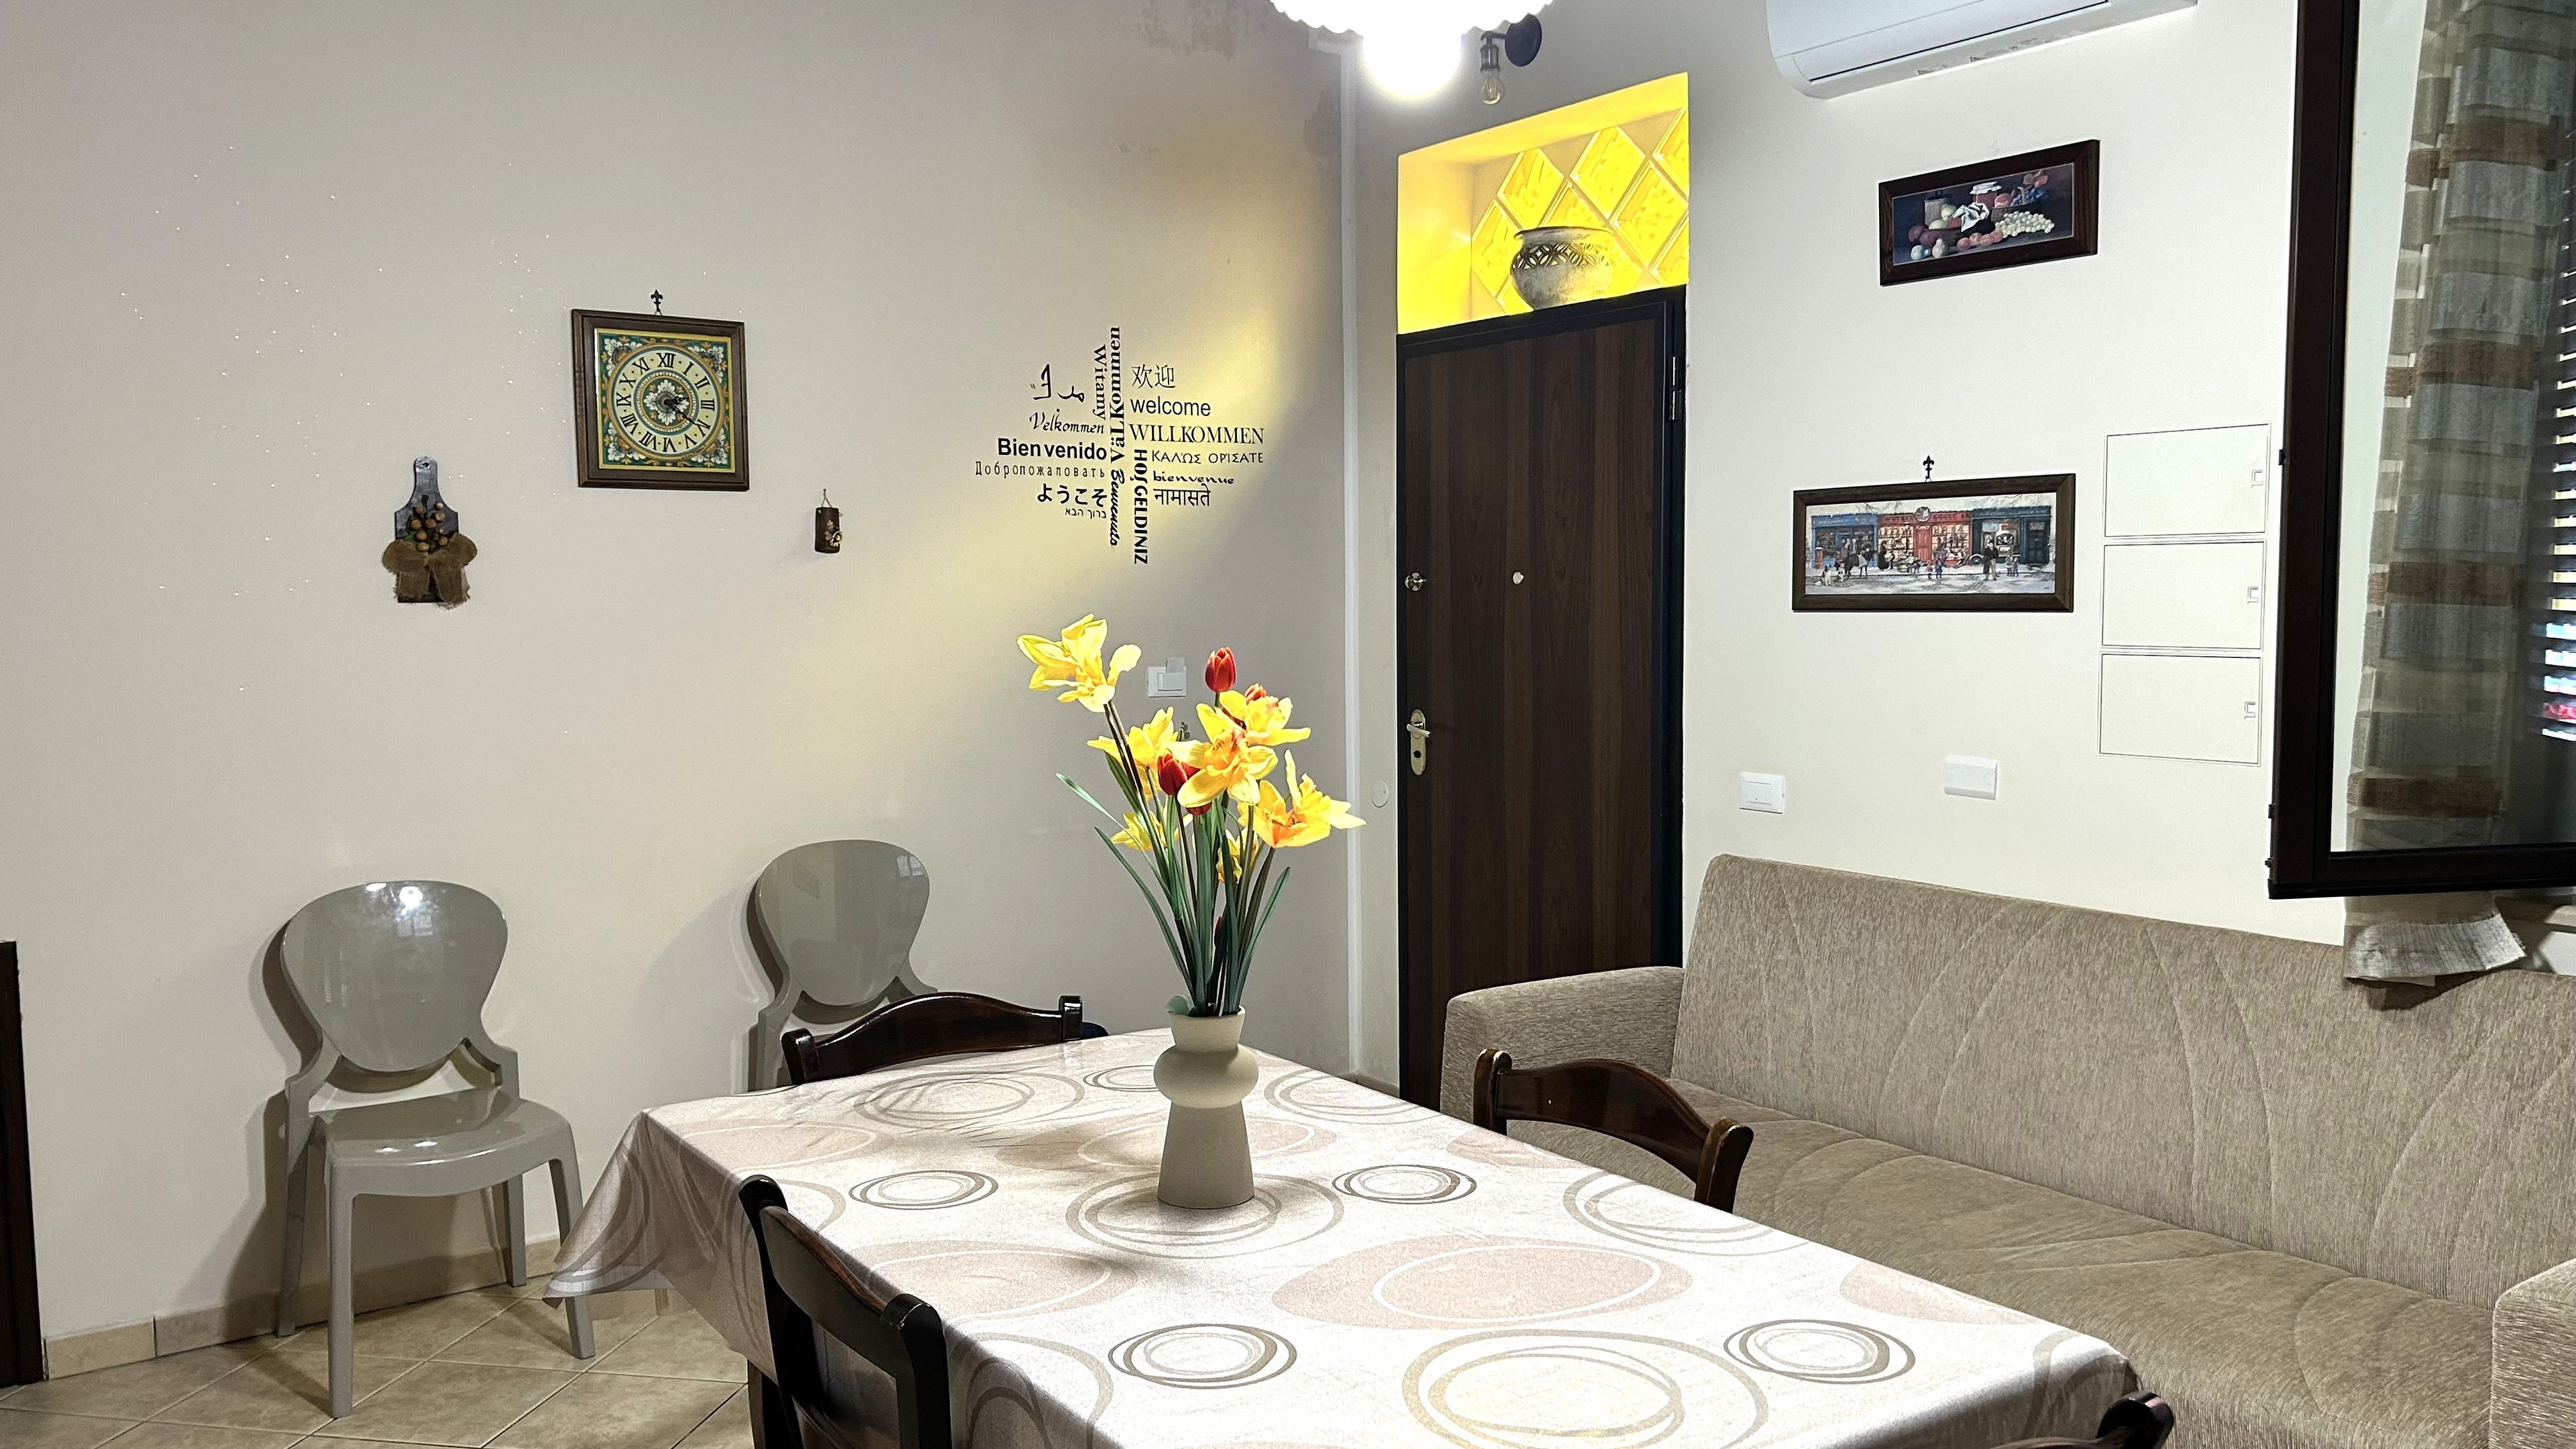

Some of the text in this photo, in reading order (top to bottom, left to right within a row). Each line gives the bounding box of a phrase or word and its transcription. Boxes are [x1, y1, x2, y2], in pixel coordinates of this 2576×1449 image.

[1093, 344, 1107, 420] Witamy
[1132, 364, 1175, 388] 欢迎
[1130, 396, 1210, 416] welcome
[1029, 411, 1104, 433] Velkommen
[1128, 424, 1264, 444] WILLKOMMEN
[976, 462, 1104, 478] Добропожаловать
[1153, 470, 1234, 484] bienvenue
[1038, 484, 1107, 507] ようこそ
[1065, 508, 1083, 516] הבא
